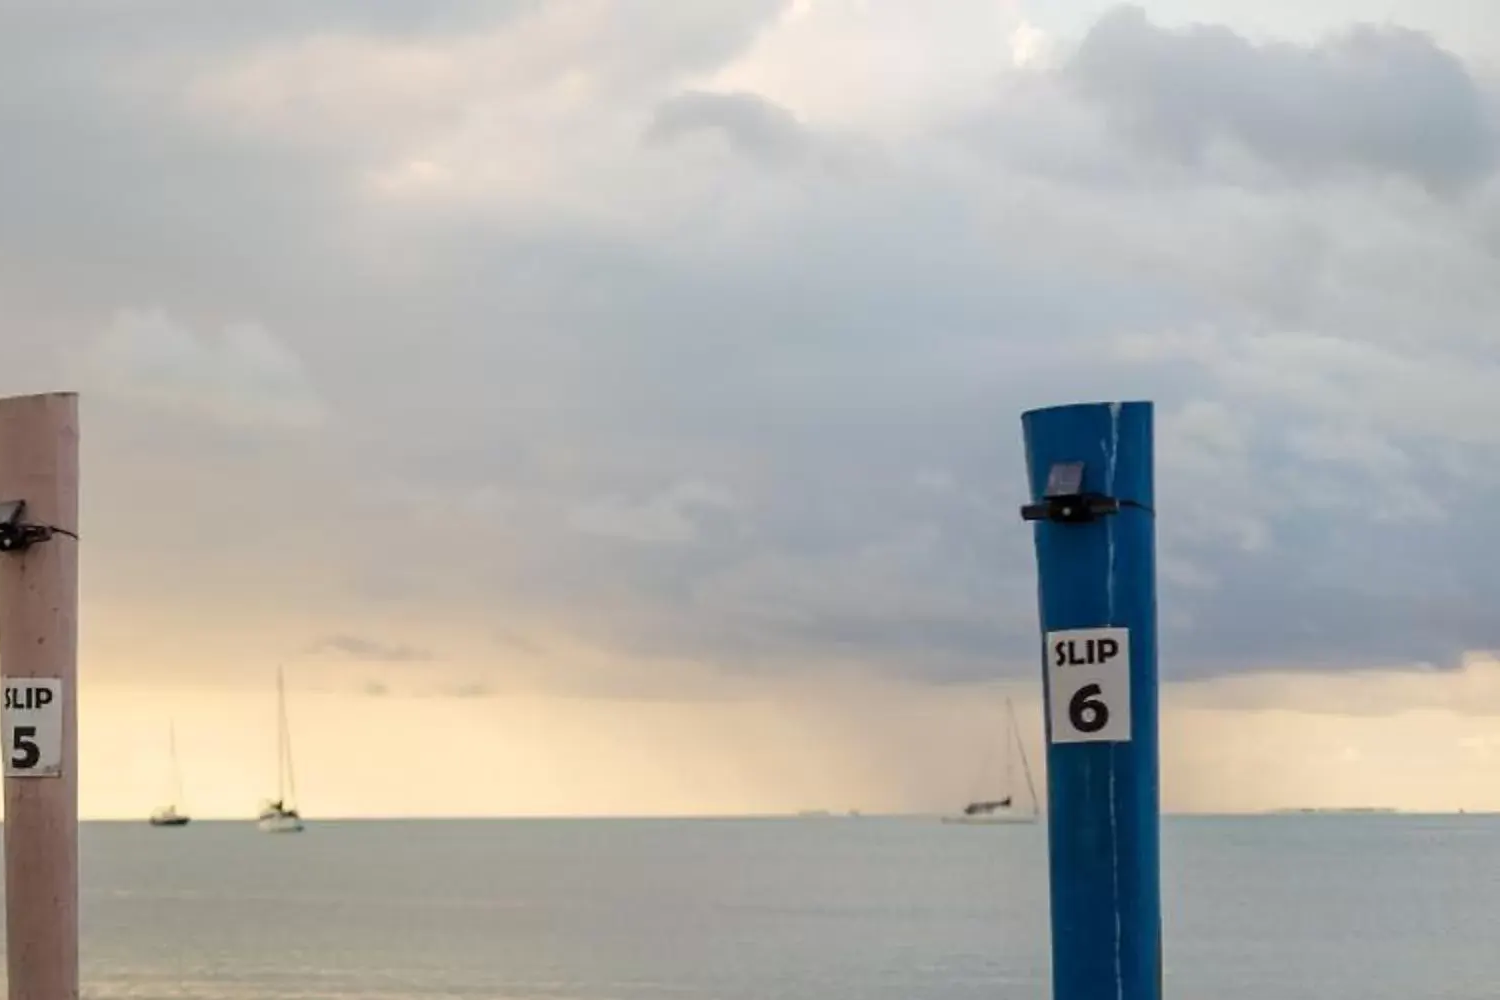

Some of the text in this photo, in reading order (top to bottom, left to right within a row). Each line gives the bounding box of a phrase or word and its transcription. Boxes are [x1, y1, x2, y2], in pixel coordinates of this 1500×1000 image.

[1055, 638, 1119, 667] SLIP
[4, 687, 53, 710] SLIP
[1069, 683, 1109, 733] 6
[11, 726, 40, 769] 5
